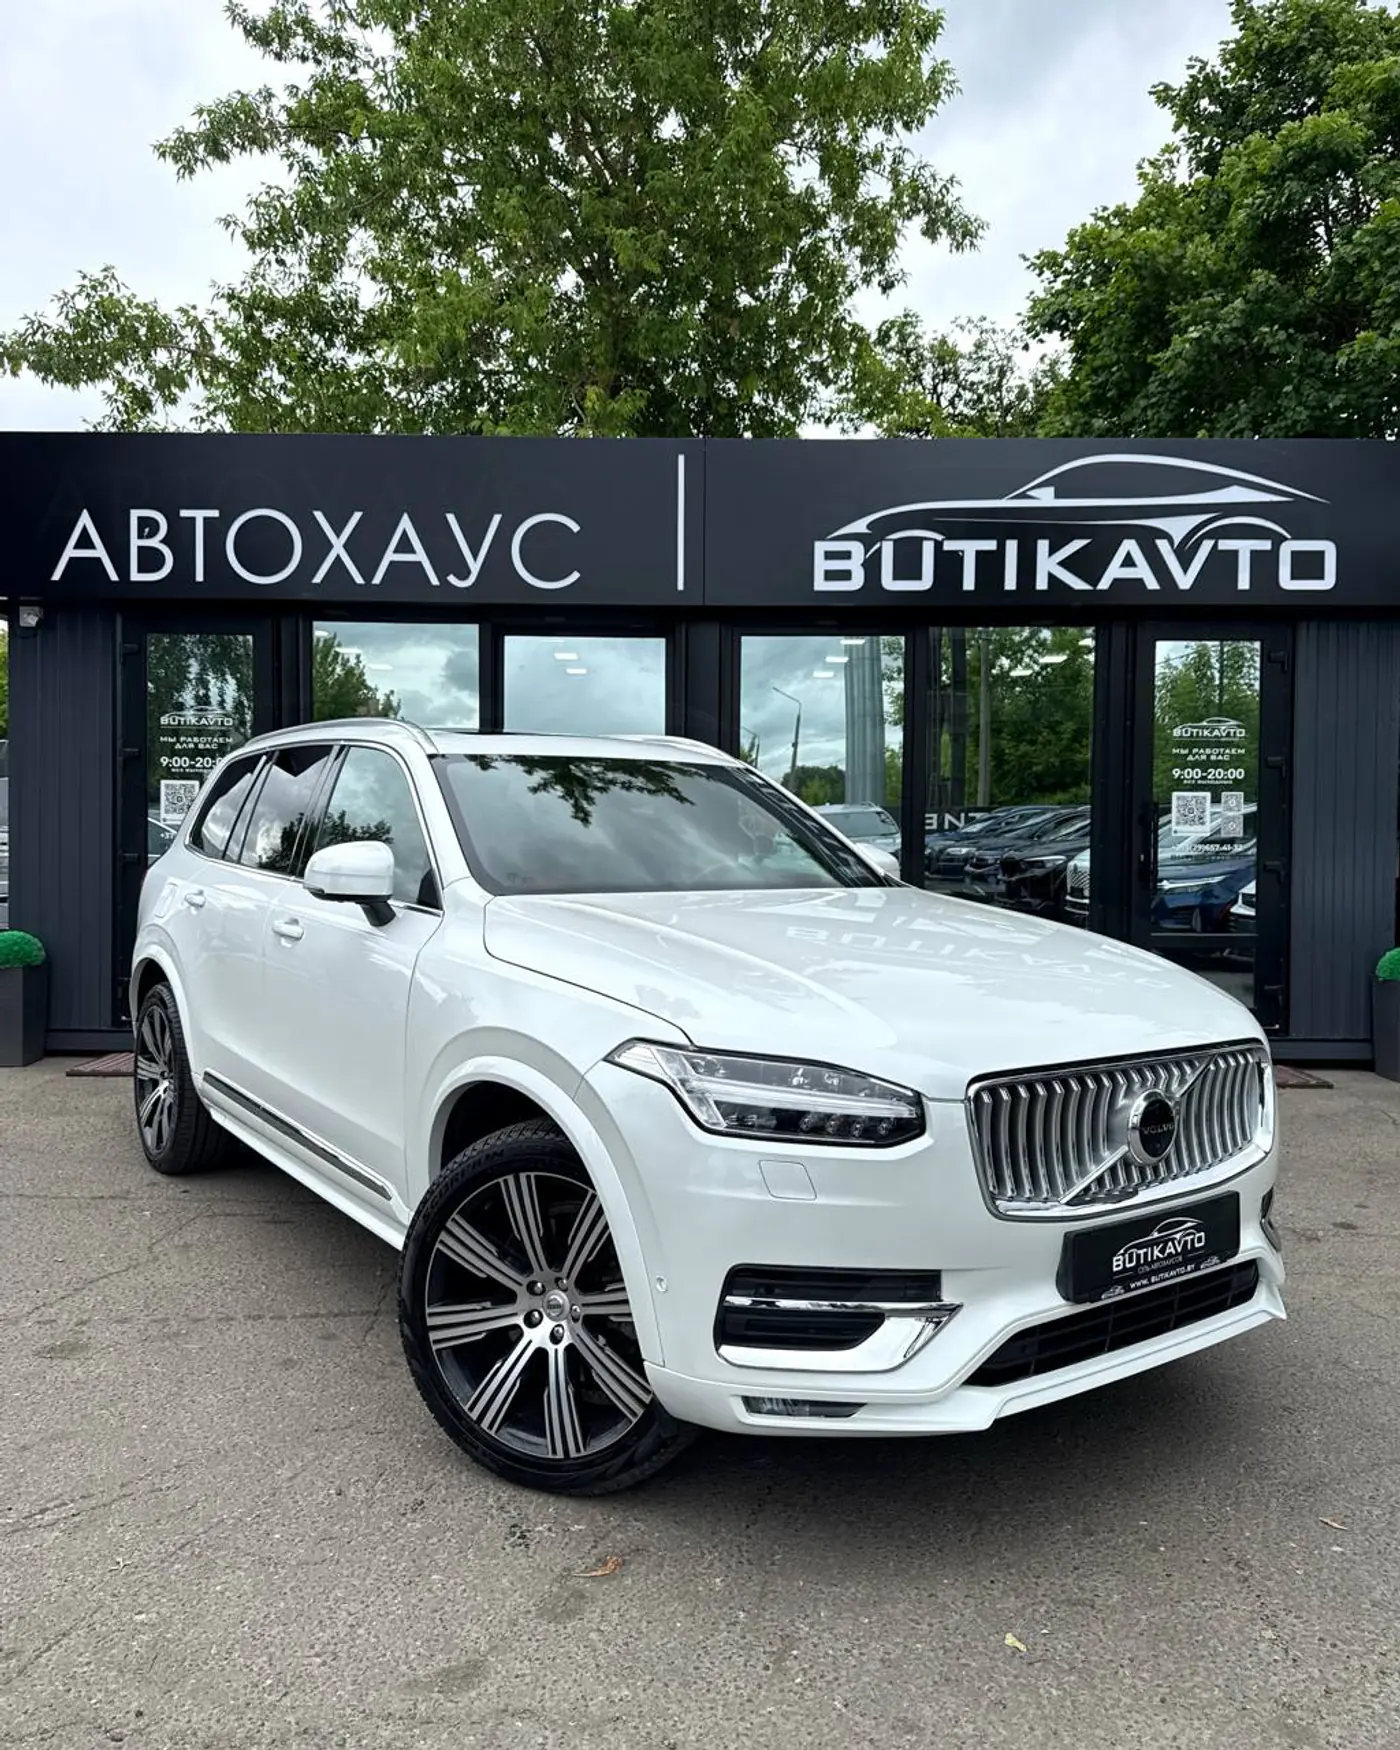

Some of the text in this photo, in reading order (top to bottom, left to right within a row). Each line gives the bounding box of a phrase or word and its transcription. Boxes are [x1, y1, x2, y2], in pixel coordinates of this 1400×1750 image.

[50, 508, 581, 590] АВТОХАУС
[813, 539, 1337, 592] BUTIKAVTO
[160, 715, 233, 726] BUTIKAVTO
[1172, 728, 1246, 737] BUTIKAVTO
[1172, 768, 1245, 780] 9:00-20:00
[1112, 1231, 1206, 1273] BUTIKAVTO
